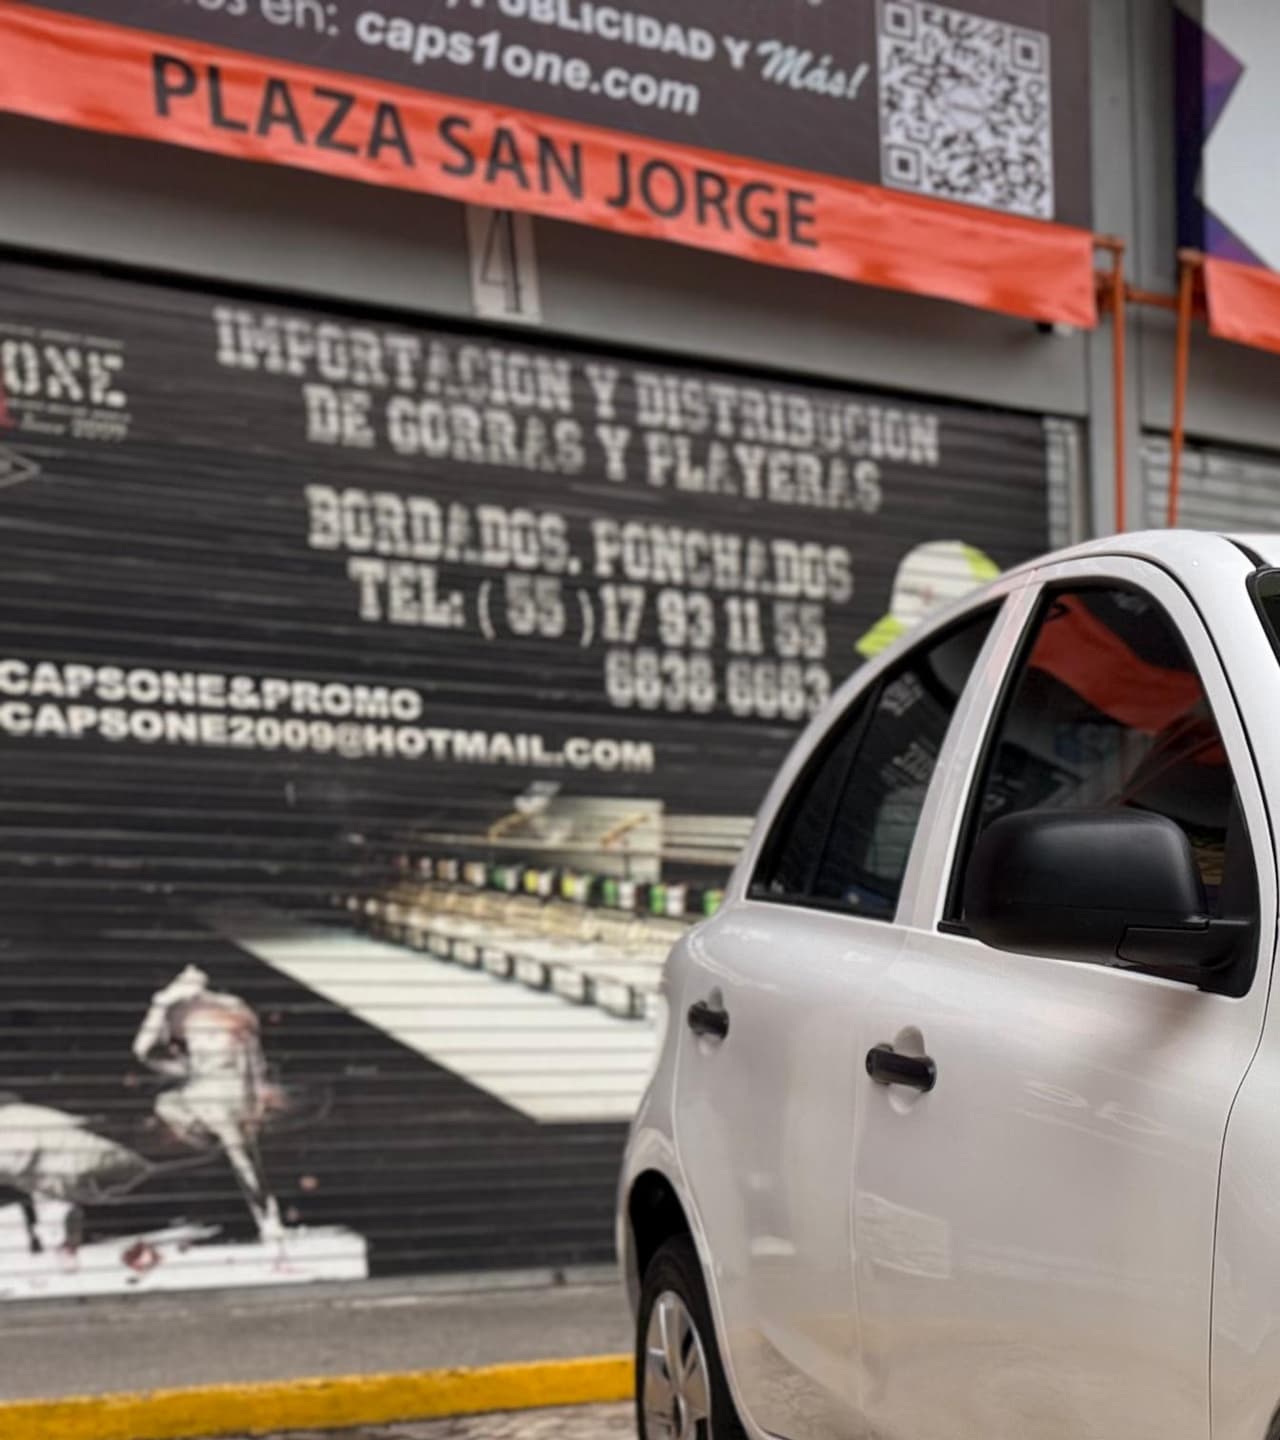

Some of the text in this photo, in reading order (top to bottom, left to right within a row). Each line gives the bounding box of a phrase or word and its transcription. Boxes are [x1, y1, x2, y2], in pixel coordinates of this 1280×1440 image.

[356, 11, 700, 115] caps1one.com
[469, 0, 869, 98] UBLICIDAD Y Más!
[151, 53, 820, 249] PLAZA SAN JORGE
[213, 306, 941, 467] IMPORTACION Y DISTRIBUCION
[302, 383, 883, 513] DE GORRAS Y PLAYERAS
[347, 556, 465, 628] TEL:
[600, 583, 646, 643] 17
[725, 595, 764, 654] 11
[773, 601, 827, 659] 55
[592, 518, 853, 603] PONCHADOS
[0, 659, 422, 720] CAPSONE&PROMO
[0, 701, 655, 774] CAPSONE2009@HOTMAIL.COM
